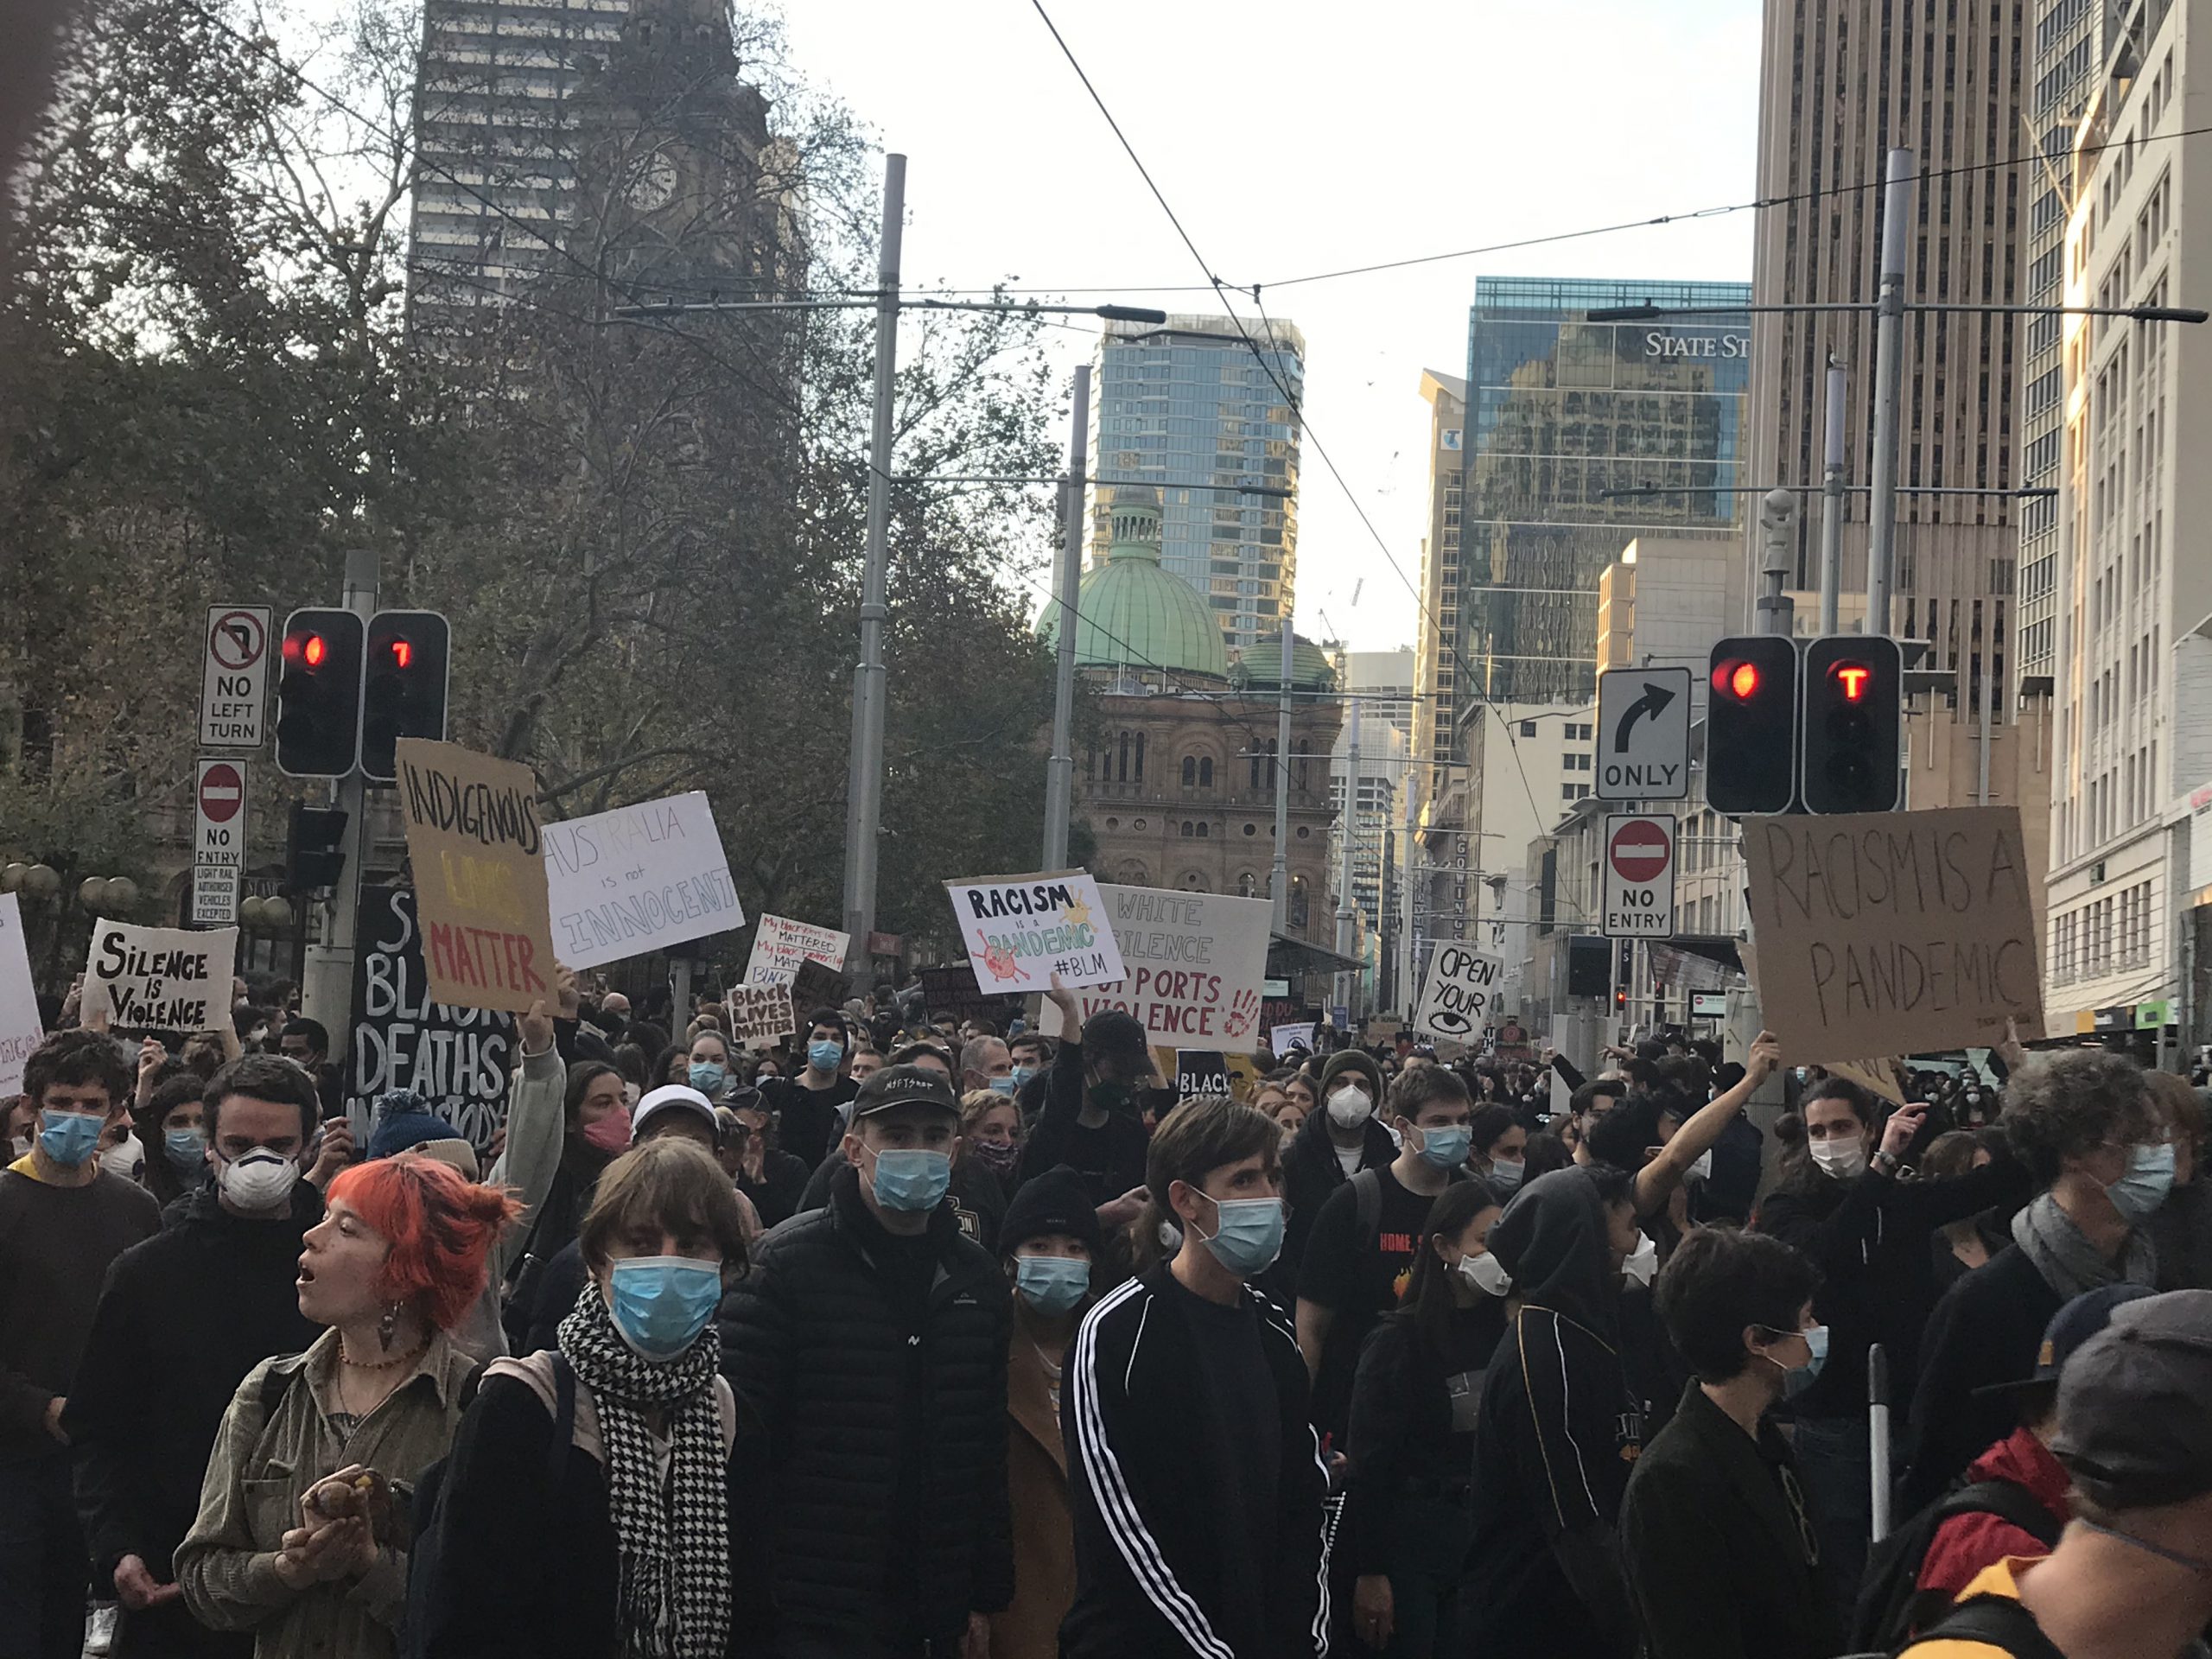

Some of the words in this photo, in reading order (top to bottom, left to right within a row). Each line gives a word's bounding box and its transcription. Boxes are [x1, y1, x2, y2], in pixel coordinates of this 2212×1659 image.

[1646, 333, 1715, 357] STATE
[1721, 335, 1749, 358] ST
[217, 676, 251, 697] NO
[212, 702, 253, 718] LEFT
[209, 723, 255, 738] TURN
[1605, 765, 1679, 786] ONLY
[403, 760, 539, 855] INDIGENOUS
[207, 829, 231, 846] NO
[543, 806, 686, 877] AUSTRALIA
[198, 851, 239, 864] ENTRY
[197, 868, 219, 879] LIGHT
[219, 868, 234, 880] RAIL
[601, 876, 617, 888] is
[625, 863, 645, 881] not
[1766, 823, 1924, 928] RACISM
[1934, 830, 1972, 912] IS
[1989, 829, 2023, 908] A
[199, 895, 232, 906] VEHICLES
[967, 884, 1075, 919] RACISM
[1623, 889, 1654, 907] NO
[197, 908, 232, 919] EXCEPTED
[560, 867, 735, 955] INNOCENT
[1117, 893, 1204, 926] WHITE
[764, 917, 778, 932] My
[1016, 920, 1025, 930] is
[1609, 913, 1666, 929] ENTRY
[757, 940, 774, 959] My
[779, 931, 836, 953] MATTERED
[988, 922, 1095, 961] PANDEMIC
[430, 921, 547, 993] MATTER
[1054, 953, 1108, 977] #BLM
[1440, 948, 1497, 986] OPEN
[144, 977, 162, 999] IS
[1810, 938, 2024, 1027] PANDEMIC
[732, 982, 790, 1007] BLACK
[1433, 980, 1486, 1018] YOUR
[733, 1001, 792, 1023] LIVES
[734, 1018, 794, 1040] MATTER
[355, 1022, 508, 1099] DEATHS
[1179, 1072, 1230, 1092] BLACK
[427, 1094, 505, 1152] STODY
